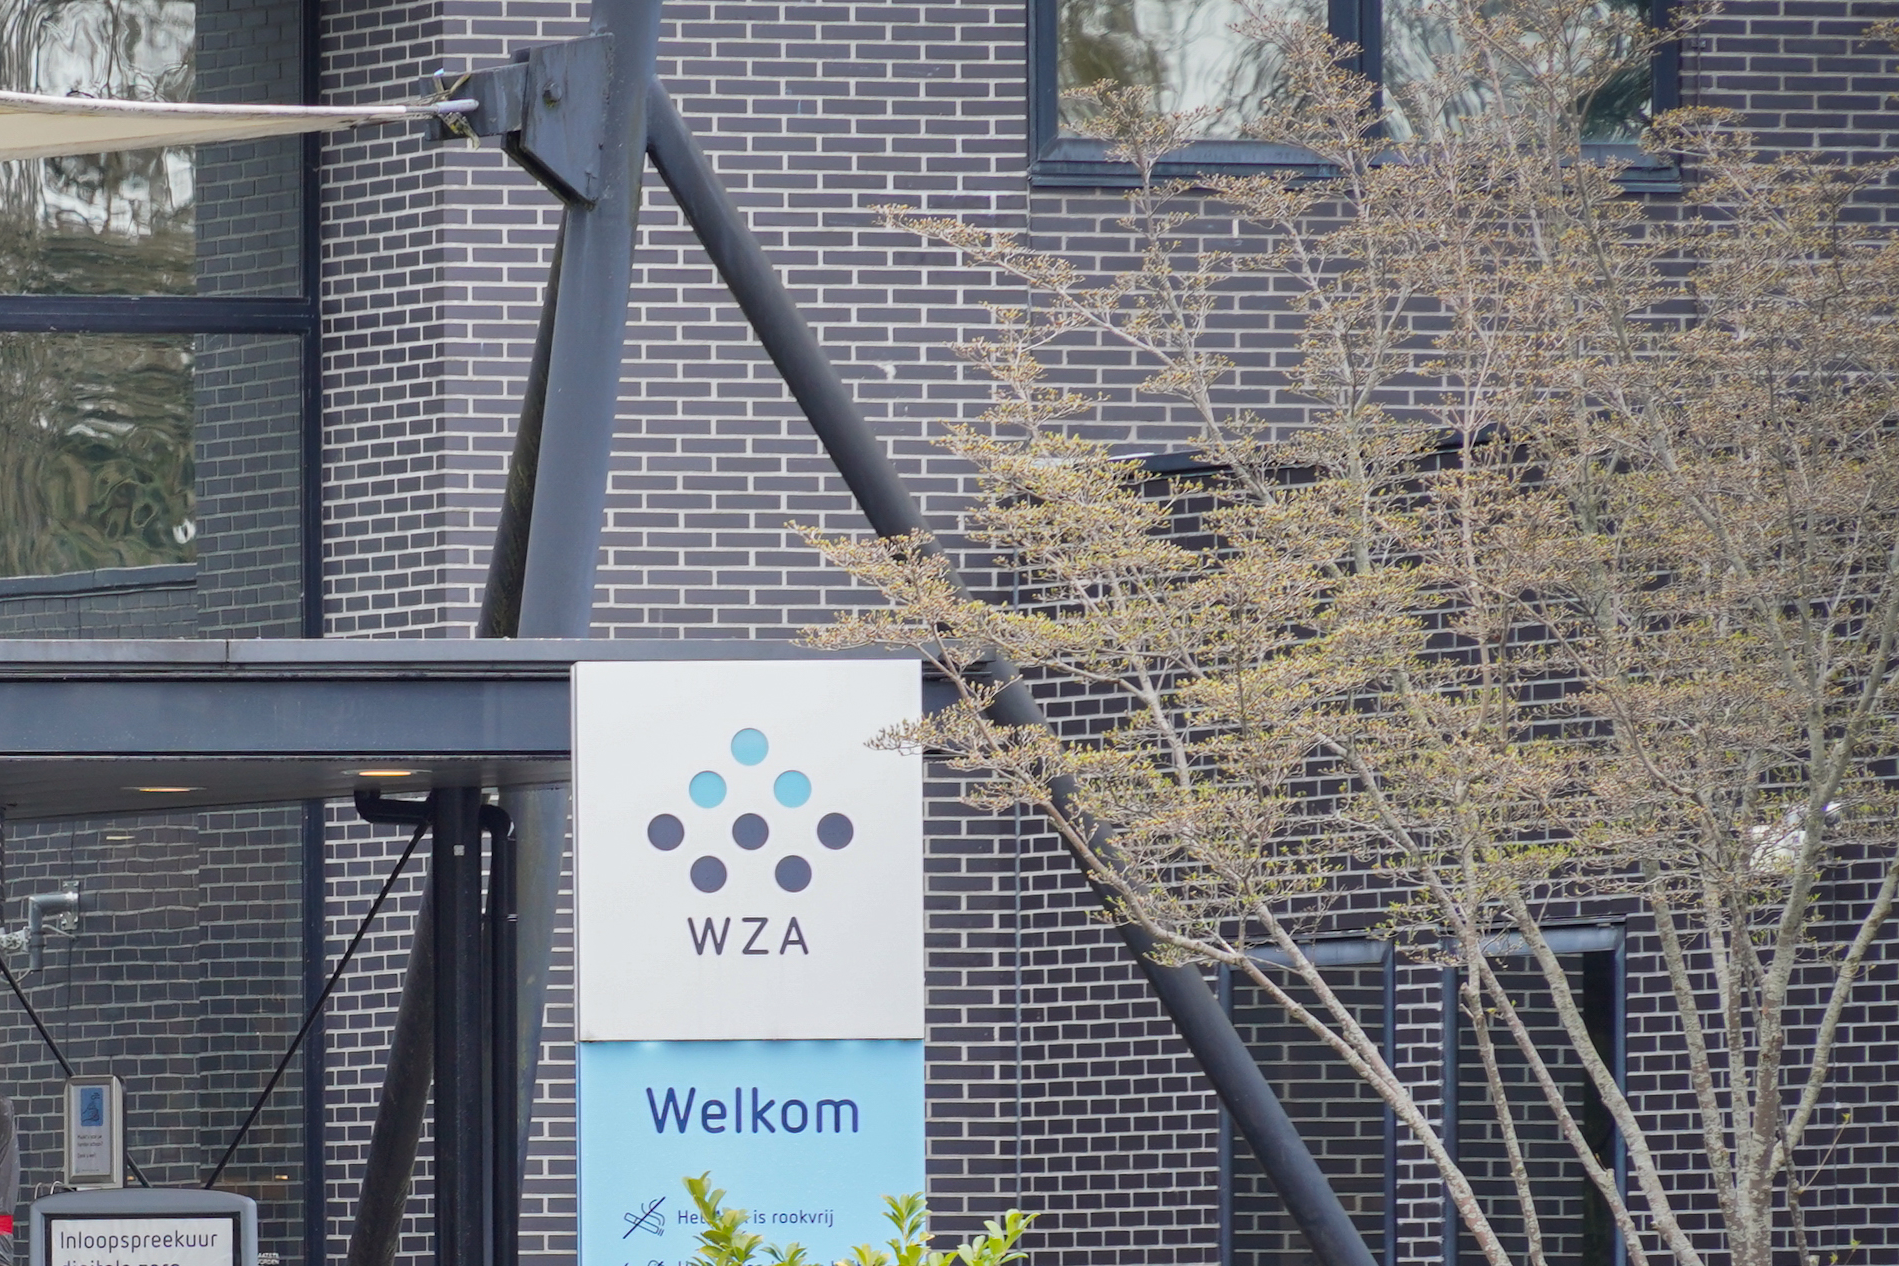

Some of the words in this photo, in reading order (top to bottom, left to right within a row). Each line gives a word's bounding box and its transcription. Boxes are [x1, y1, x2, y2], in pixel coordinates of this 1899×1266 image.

[687, 916, 809, 956] WZA
[646, 1086, 859, 1134] Welkom
[753, 1209, 766, 1224] is
[772, 1209, 834, 1228] rookvrij
[60, 1230, 218, 1253] Inloopspreekuur
